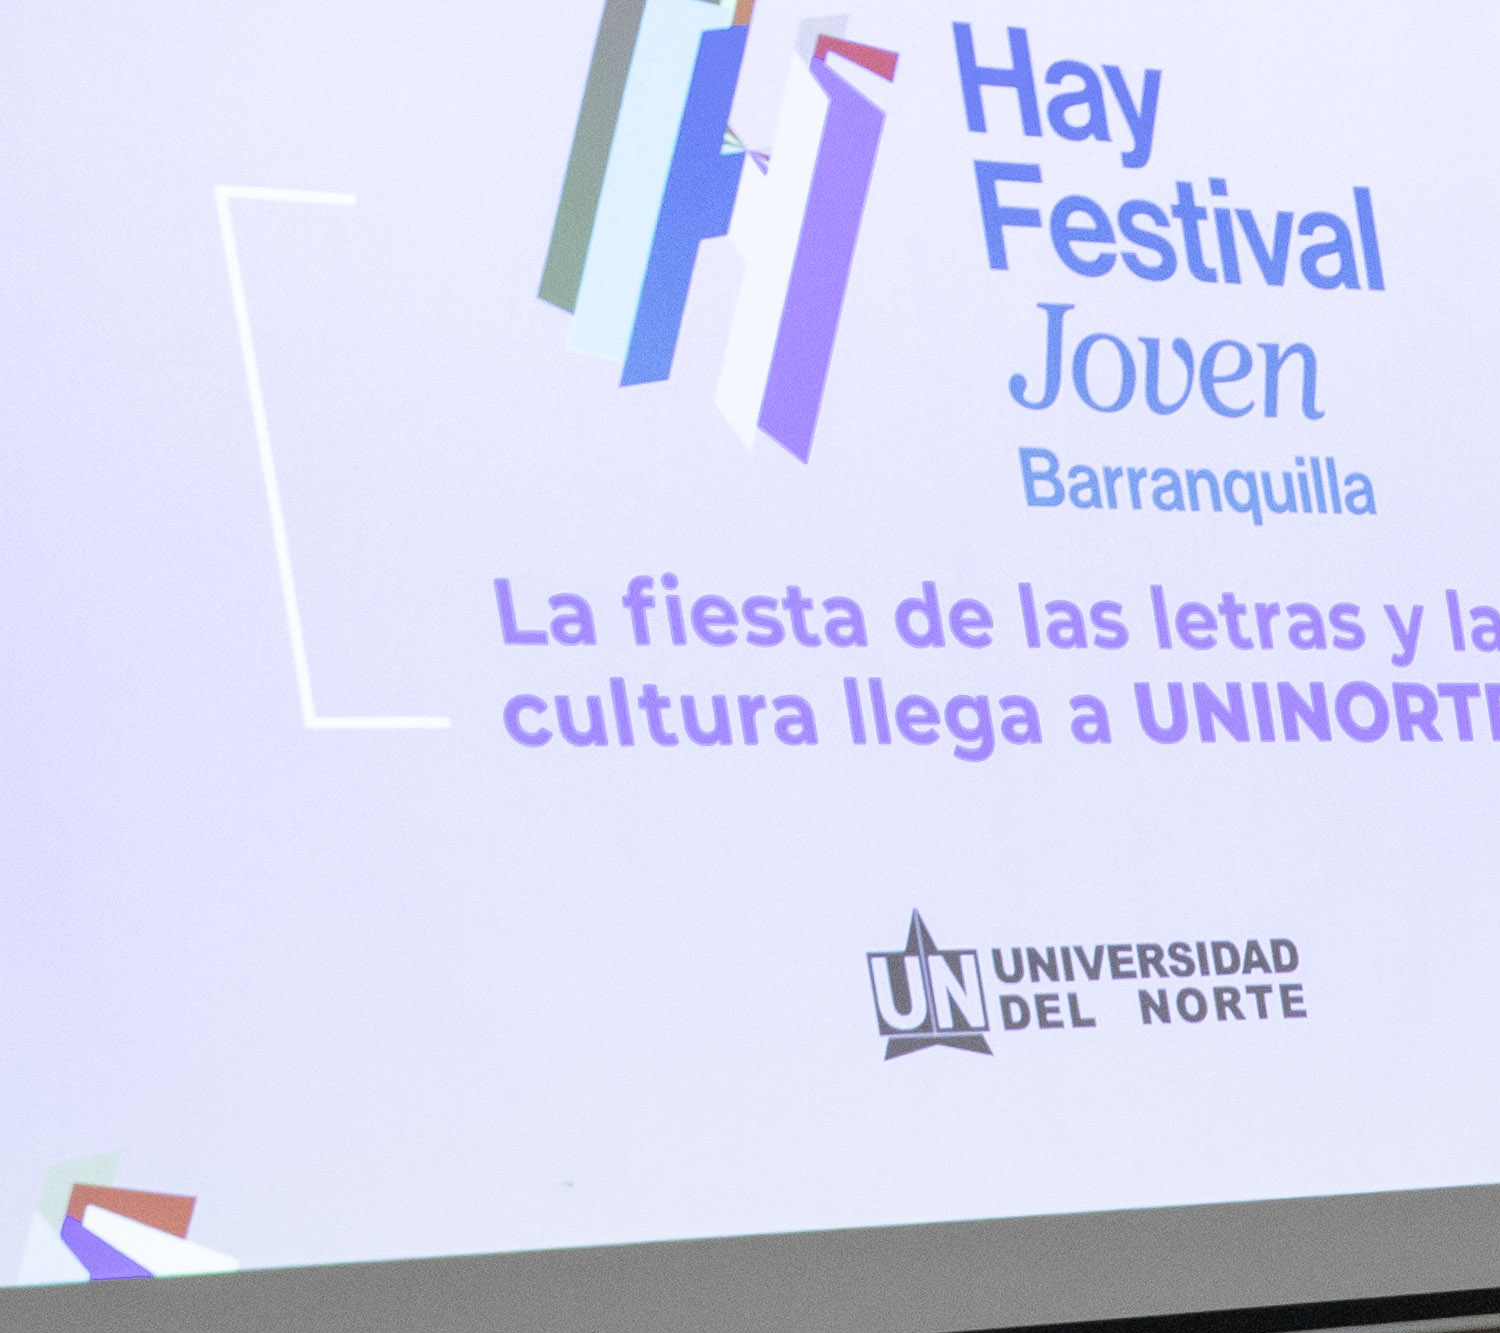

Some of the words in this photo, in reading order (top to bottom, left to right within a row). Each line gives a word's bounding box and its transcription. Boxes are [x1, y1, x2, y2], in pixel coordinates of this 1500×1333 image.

[951, 20, 1162, 169] Hay
[973, 159, 1386, 292] Festival
[1007, 301, 1325, 420] Joven
[1018, 447, 1378, 526] Barranquilla
[493, 577, 597, 647] La
[622, 572, 870, 649] fiesta
[894, 579, 995, 651] de
[1017, 581, 1129, 650] las
[1149, 584, 1366, 651] letras
[1384, 603, 1424, 668] y
[501, 676, 819, 749] cultura
[843, 676, 1043, 762] llega
[1069, 693, 1112, 745] a
[868, 957, 988, 1034] UN
[991, 939, 1300, 984] UNIVERSIDAD
[999, 993, 1096, 1031] DEL
[1139, 982, 1309, 1024] NORTE
